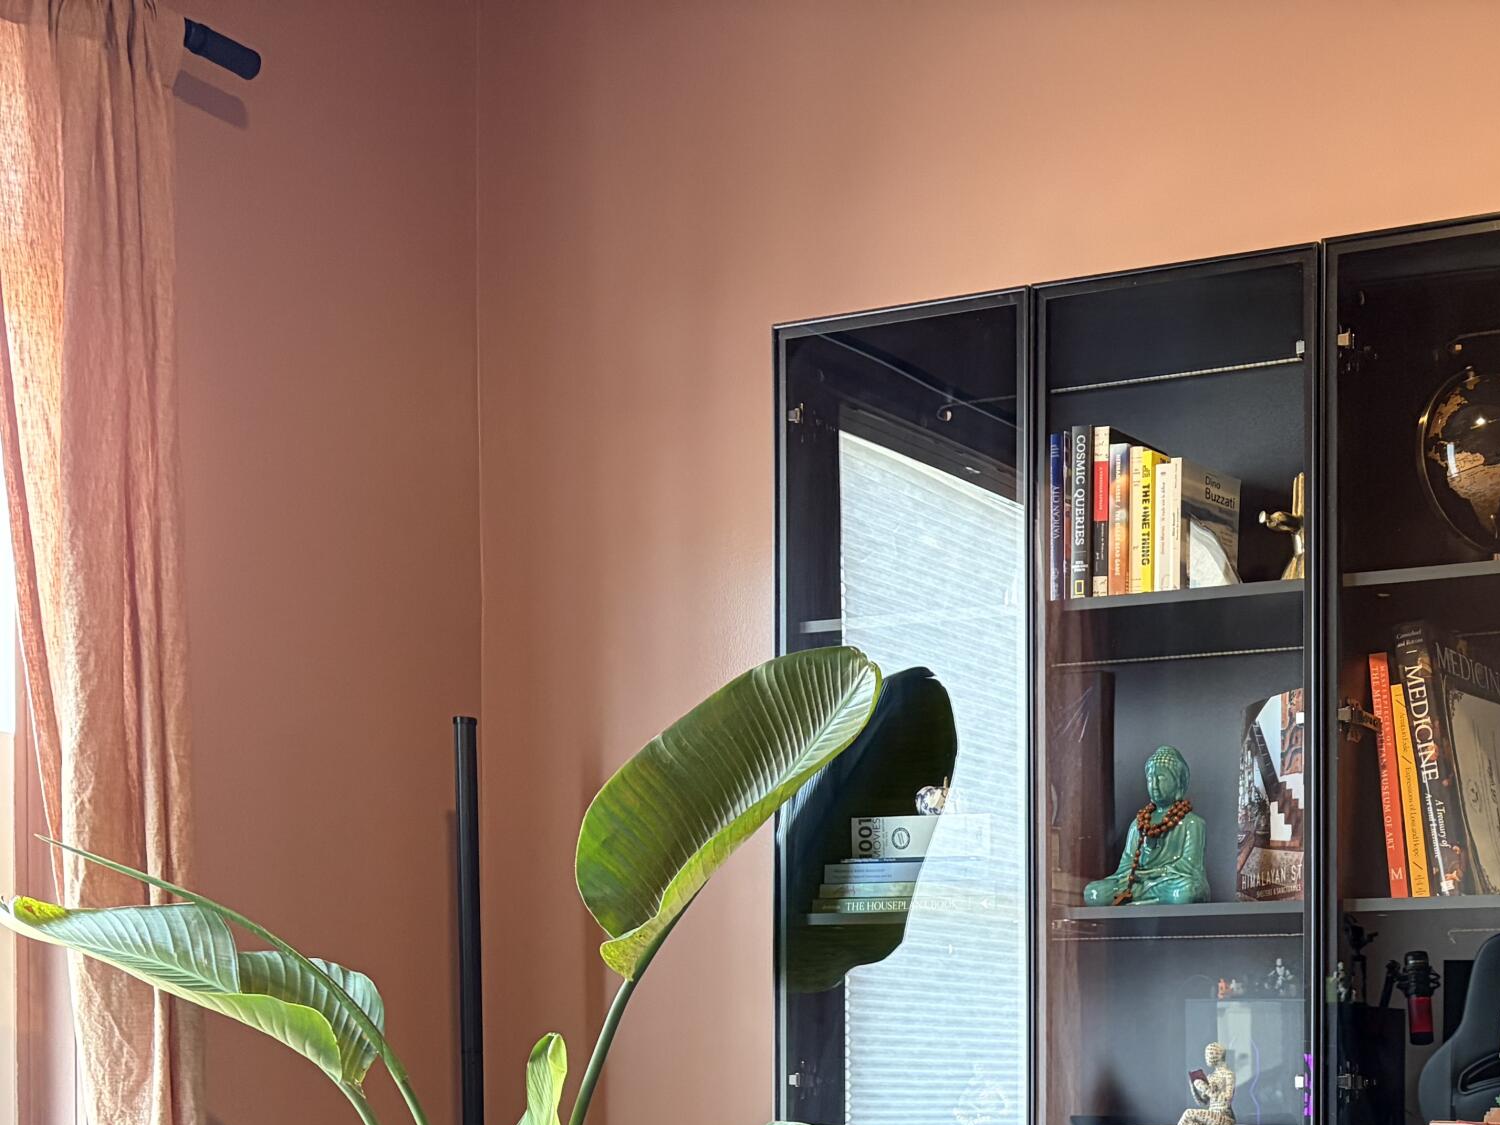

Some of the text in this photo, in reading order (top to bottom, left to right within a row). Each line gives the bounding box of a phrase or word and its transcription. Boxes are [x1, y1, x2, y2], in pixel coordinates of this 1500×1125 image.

[1074, 435, 1086, 546] COSMIC QUERIES
[1141, 483, 1151, 504] THE
[1205, 475, 1221, 490] Dino
[1205, 486, 1235, 509] Buzzati
[1053, 484, 1061, 539] VATICAN CITY
[1141, 532, 1151, 566] THING
[1370, 665, 1380, 687] THE
[1404, 664, 1440, 783] MEDICINE
[1381, 769, 1391, 814] MUSEUM
[1385, 816, 1392, 829] OF
[1436, 806, 1447, 838] Treasury
[1386, 832, 1394, 850] ART
[1440, 839, 1451, 849] of
[1242, 867, 1288, 890] HIMALAYAN
[846, 902, 865, 912] THE
[866, 900, 922, 912] HOUSEPL
